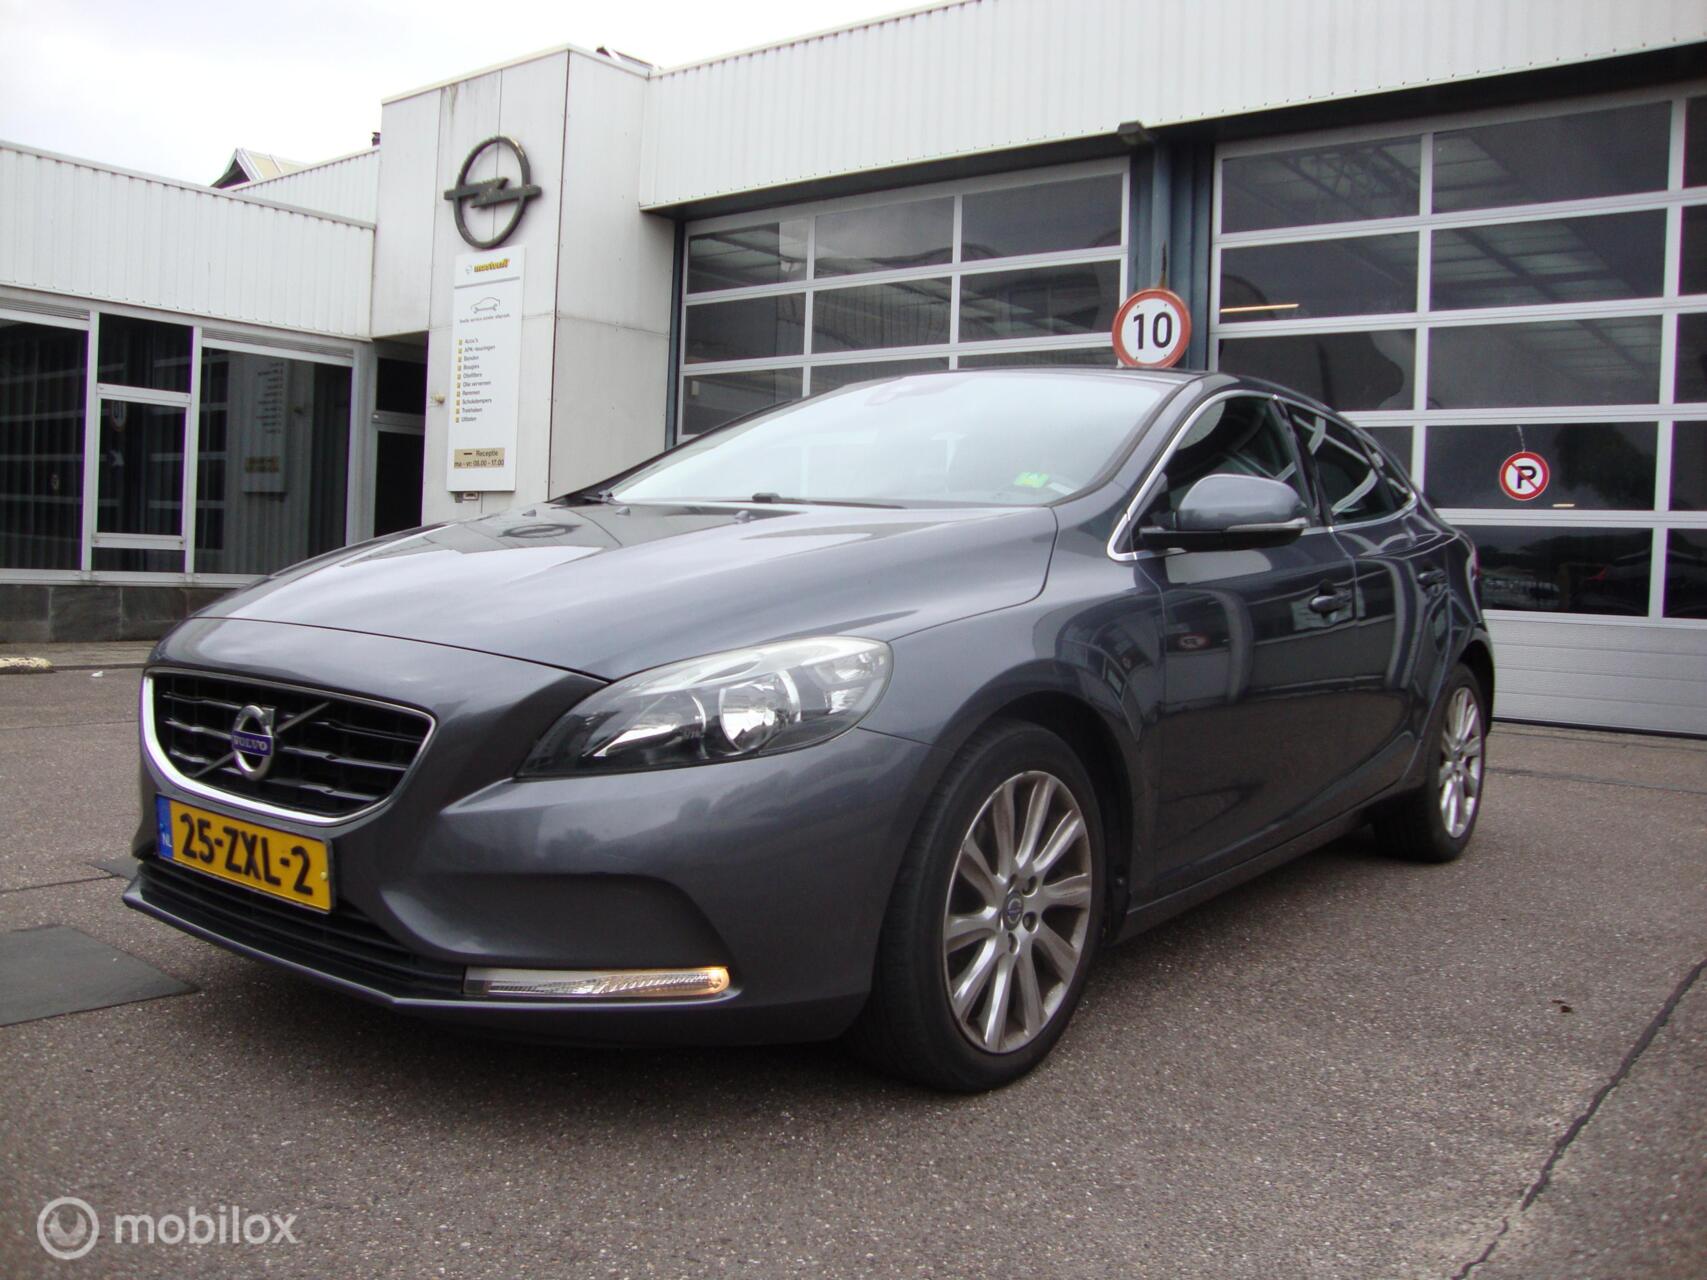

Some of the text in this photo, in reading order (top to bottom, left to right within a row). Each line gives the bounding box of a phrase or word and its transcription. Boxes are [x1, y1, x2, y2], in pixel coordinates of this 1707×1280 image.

[1133, 311, 1172, 350] 10
[233, 735, 268, 751] VOLVO
[180, 812, 313, 896] 25-ZXL-2
